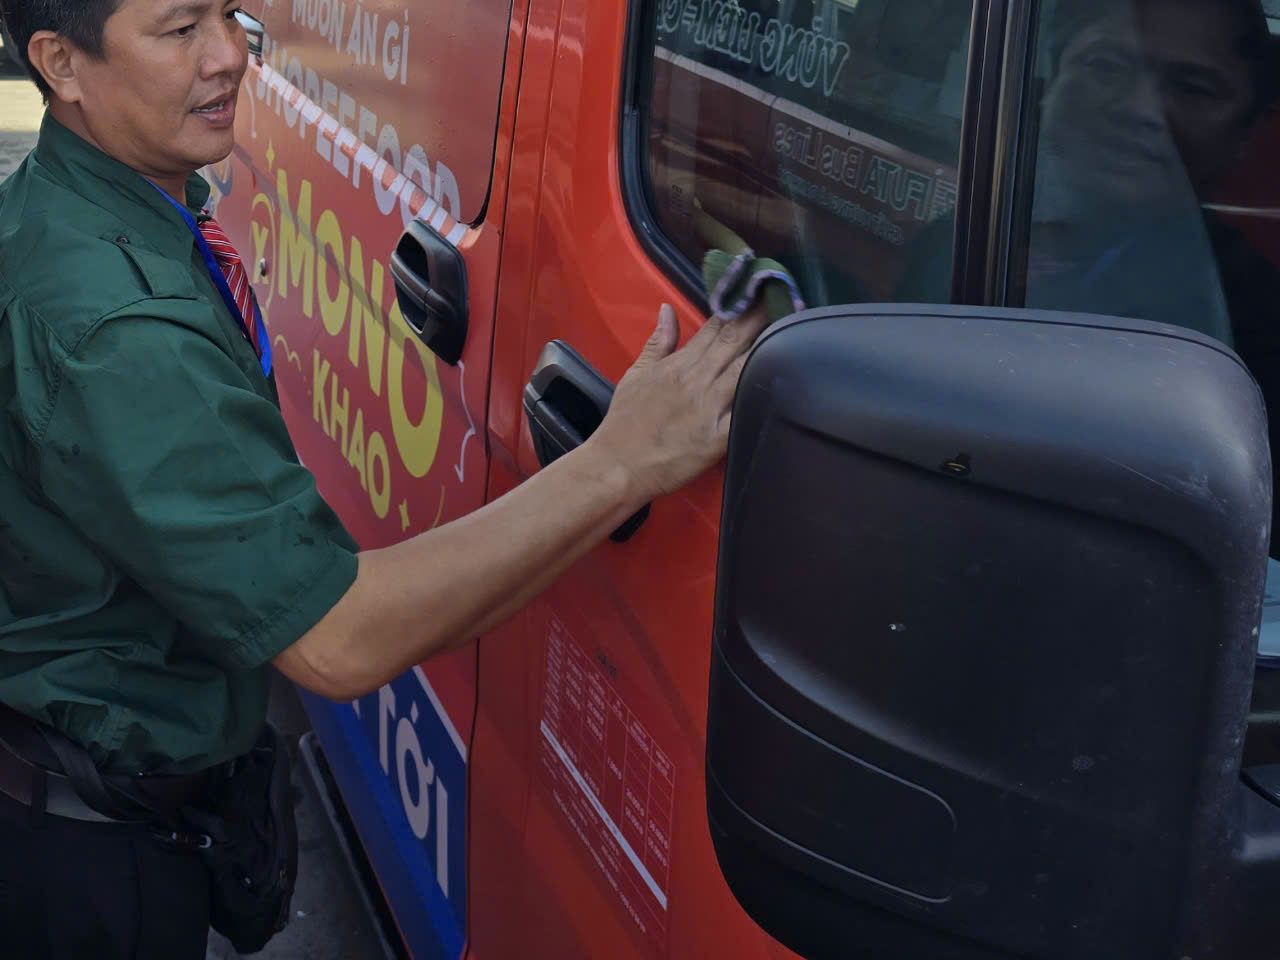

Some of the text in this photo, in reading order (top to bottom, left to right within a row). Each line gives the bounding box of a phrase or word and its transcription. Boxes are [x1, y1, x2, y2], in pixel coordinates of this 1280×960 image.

[383, 8, 409, 85] GÌ
[276, 169, 444, 478] MONO
[312, 348, 391, 519] KHAO
